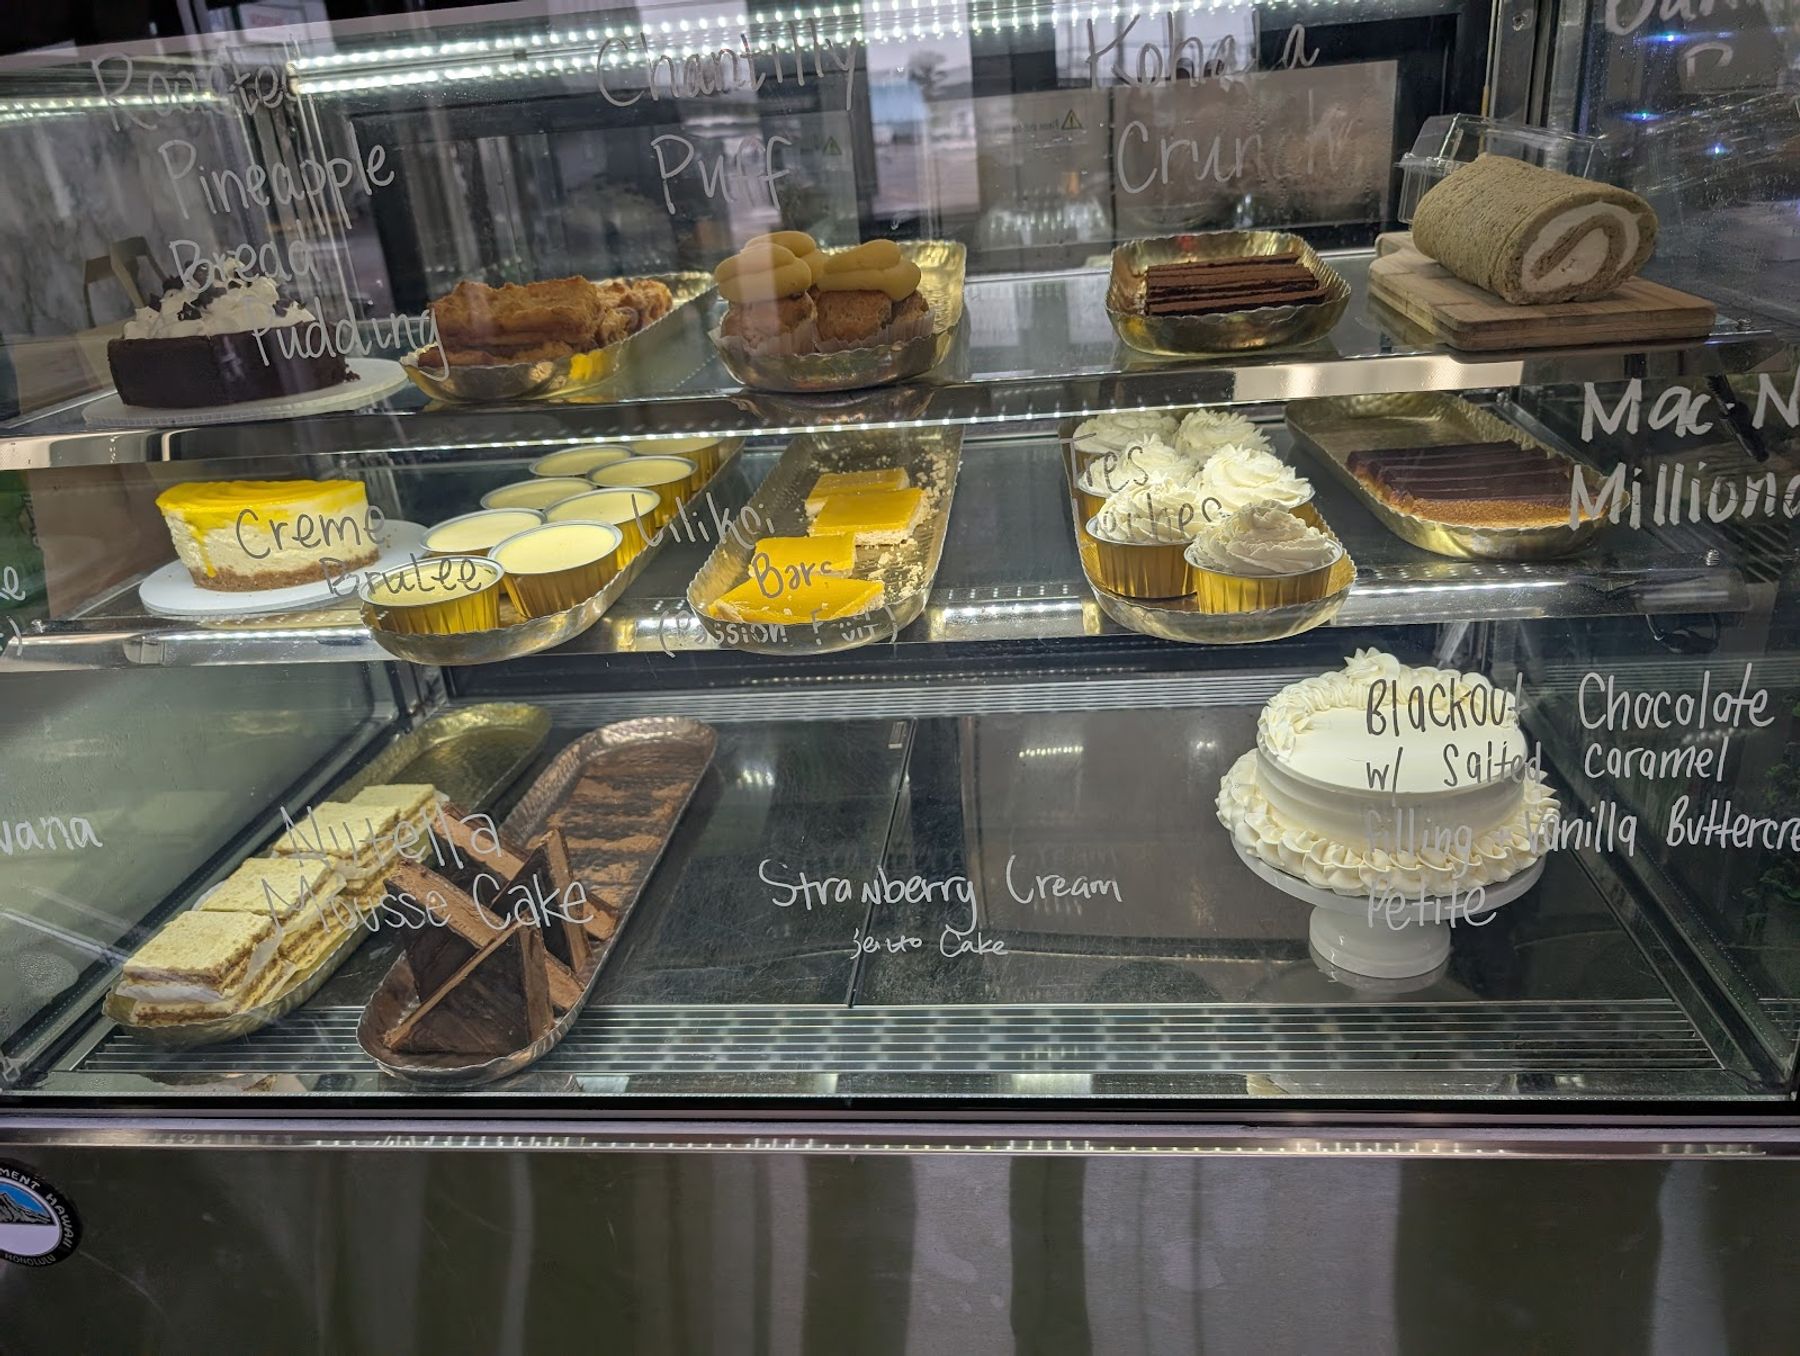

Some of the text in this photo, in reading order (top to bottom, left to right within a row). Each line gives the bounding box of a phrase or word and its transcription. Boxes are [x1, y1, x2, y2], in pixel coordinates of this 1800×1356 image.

[597, 18, 858, 110] Chantilly
[1085, 10, 1321, 90] Kohala
[158, 121, 395, 232] Pineapple
[651, 134, 792, 214] Puff
[169, 219, 321, 293] Bread
[243, 296, 450, 381] Pudding
[1581, 377, 1714, 443] Mac
[236, 505, 386, 560] Creme
[1366, 662, 1776, 736] Blackout Chocolate
[1443, 740, 1542, 787] Salted
[280, 805, 504, 870] Nutella
[261, 872, 595, 933] Mousse Cake
[1366, 872, 1497, 931] Petite
[939, 924, 1009, 958] Cake
[46, 1193, 75, 1249] HAWAII
